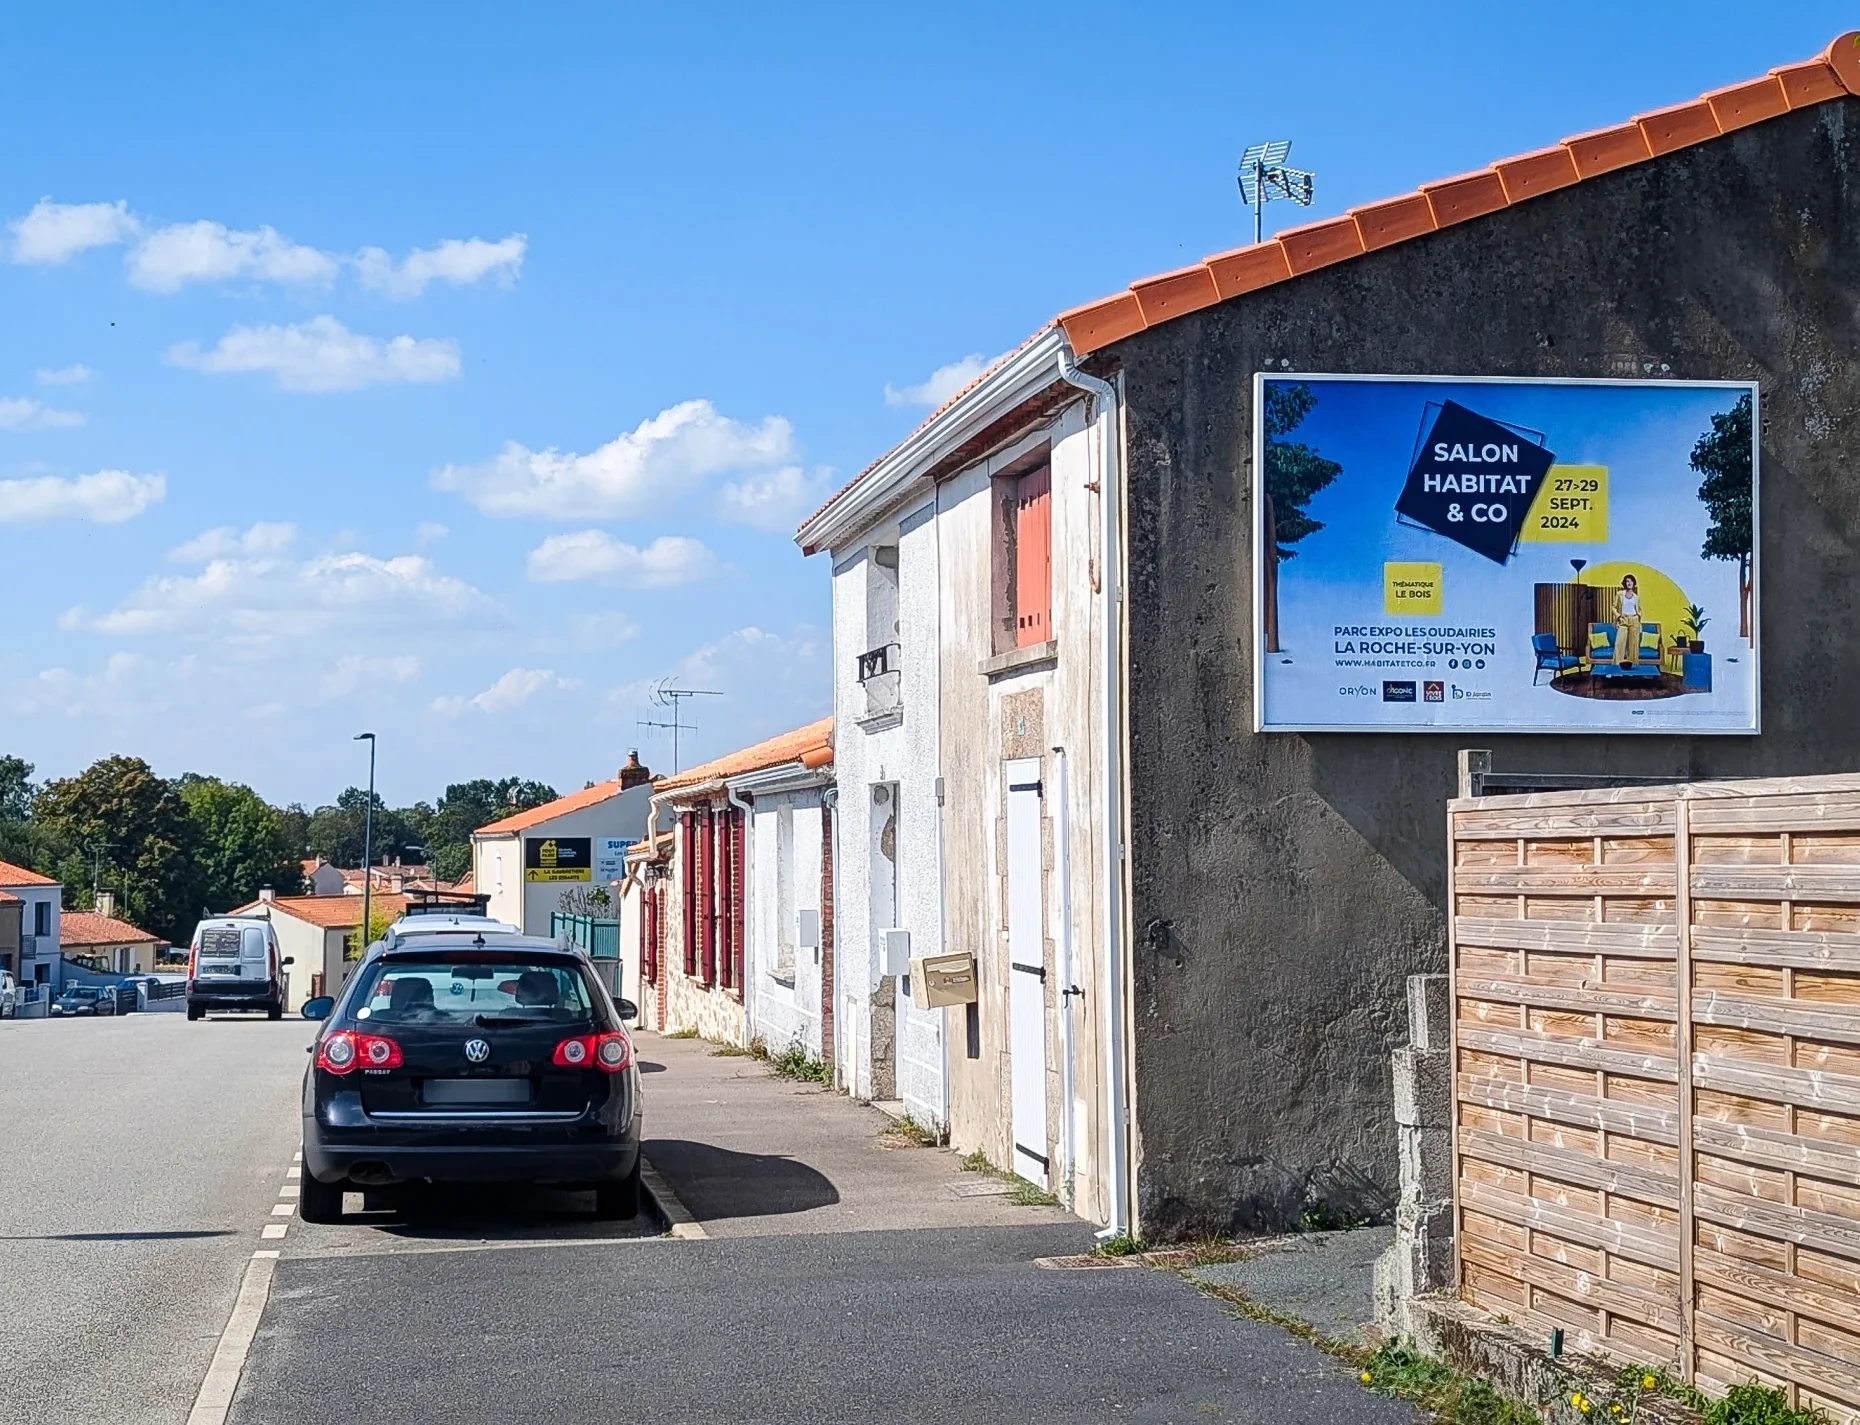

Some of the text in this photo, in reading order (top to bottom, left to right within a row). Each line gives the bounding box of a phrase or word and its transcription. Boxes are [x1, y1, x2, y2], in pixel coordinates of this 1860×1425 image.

[1434, 443, 1518, 463] SALON
[1424, 473, 1531, 494] HABITAT
[1555, 479, 1599, 492] 27>29
[1550, 498, 1593, 511] SEPT.
[1447, 503, 1508, 523] & CO
[1540, 516, 1580, 530] 2024
[1395, 590, 1432, 599] LE BOIS
[1334, 626, 1496, 638] PARC EXPO LES OUDAIRIES
[1335, 641, 1495, 656] LA ROCHE-SUR-YON
[1335, 659, 1436, 668] WWW.HABITATETCO.FR
[1339, 685, 1377, 699] ORYON
